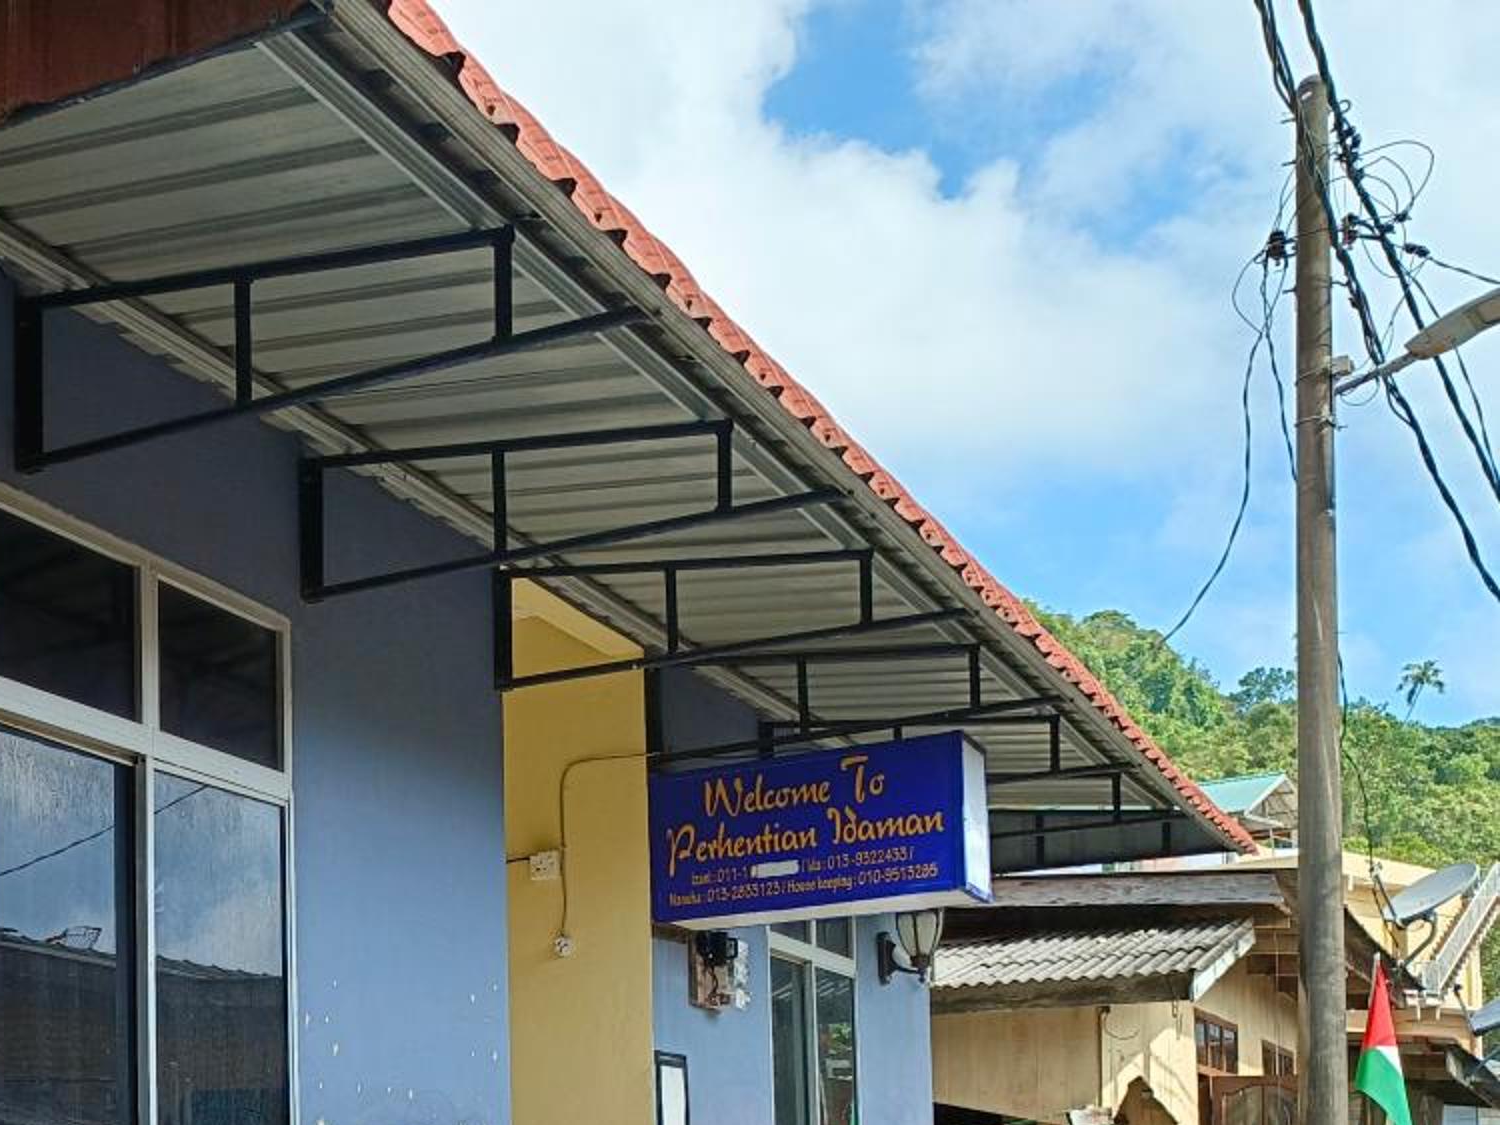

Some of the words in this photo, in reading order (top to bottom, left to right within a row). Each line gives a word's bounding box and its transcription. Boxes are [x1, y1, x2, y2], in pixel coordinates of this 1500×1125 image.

[704, 773, 831, 817] Welcome
[840, 755, 885, 803] To
[666, 822, 818, 877] Perhentian
[827, 806, 945, 845] Idaman
